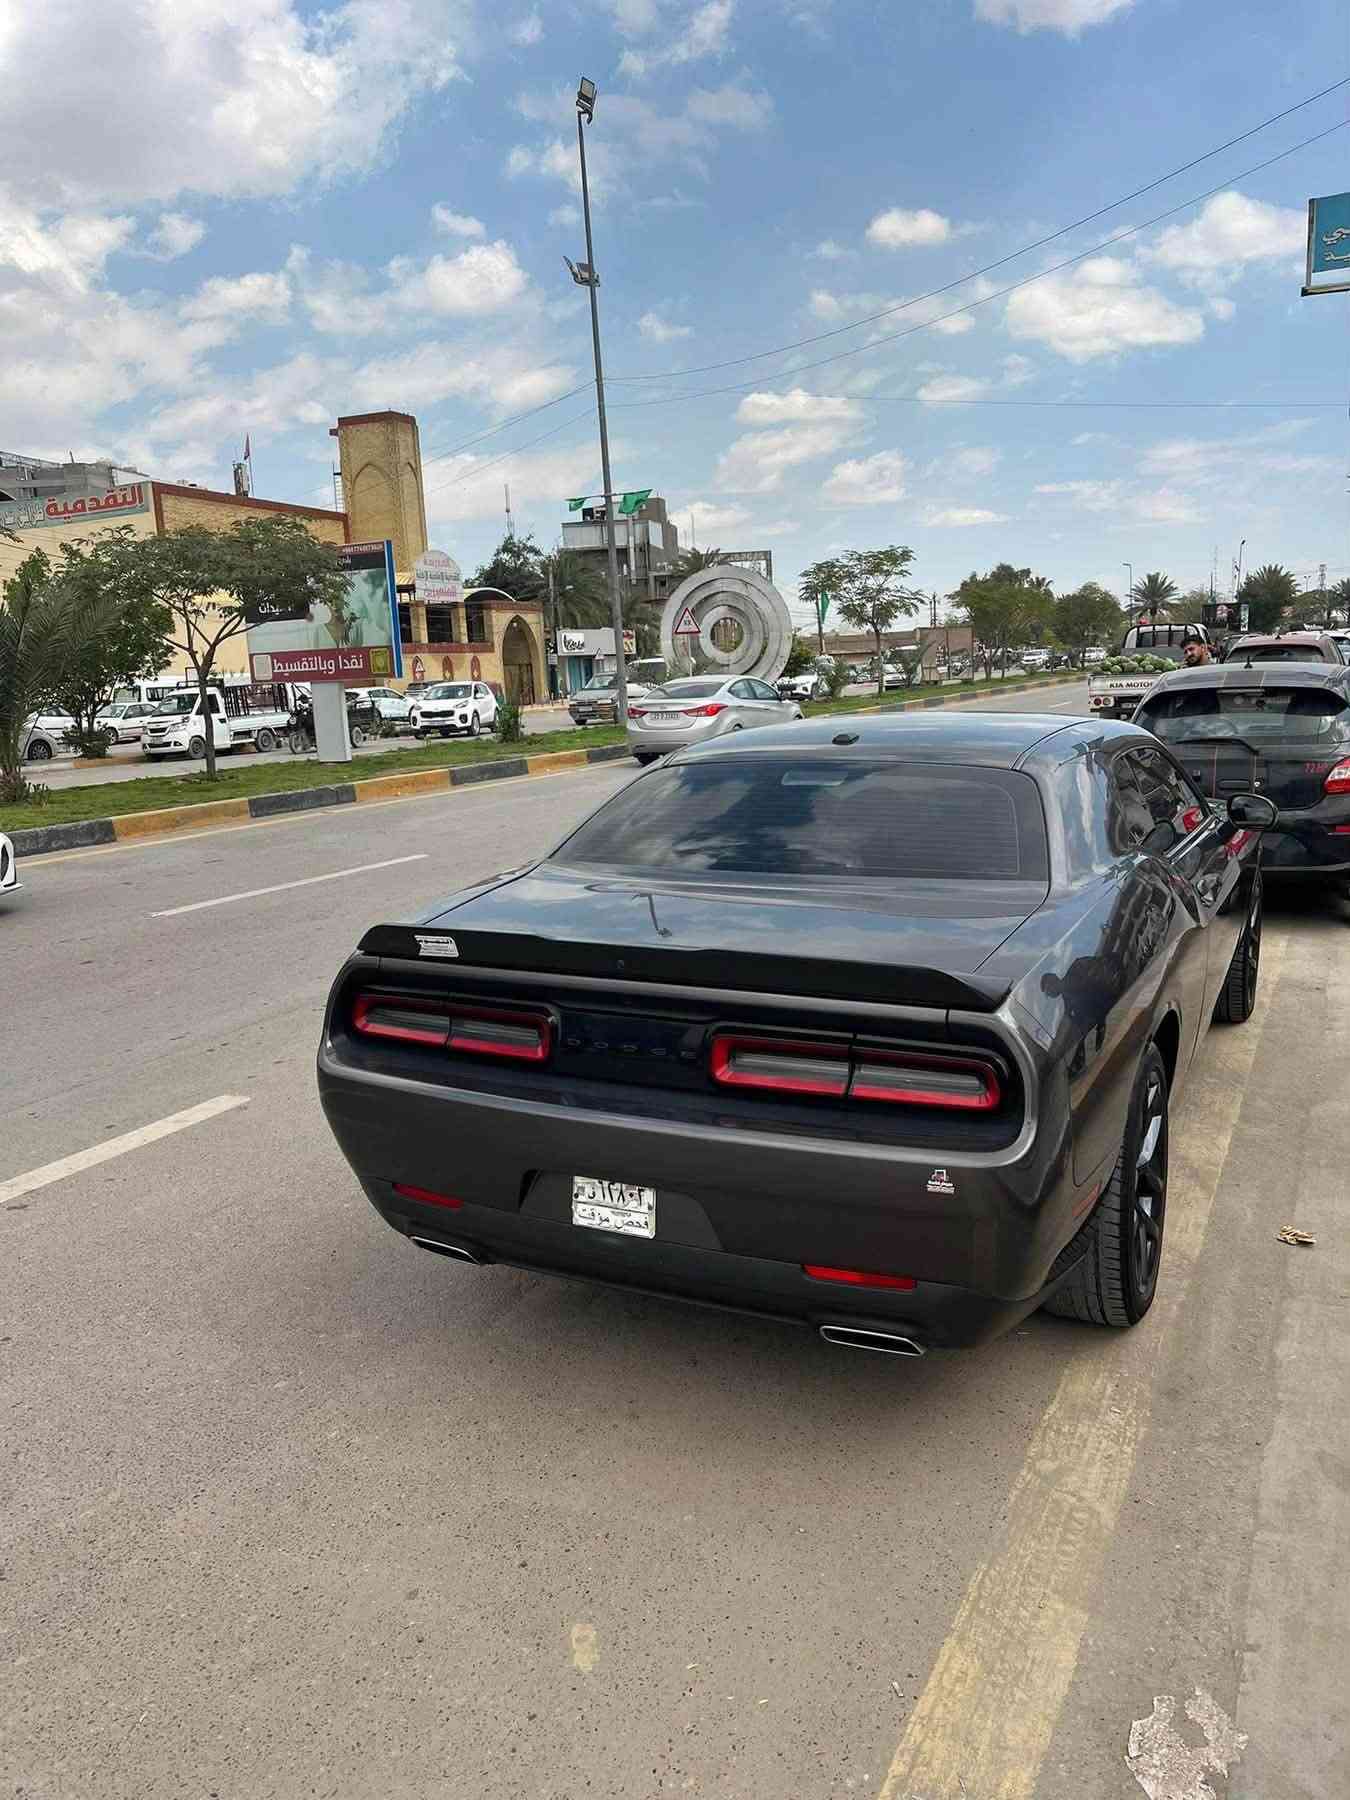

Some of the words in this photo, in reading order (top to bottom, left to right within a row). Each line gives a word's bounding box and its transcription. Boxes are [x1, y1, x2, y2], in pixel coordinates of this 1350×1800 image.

[46, 486, 144, 523] التقدمية
[273, 655, 335, 676] وبالتقسيط
[339, 654, 364, 670] نقدا
[1109, 681, 1124, 689] KIA
